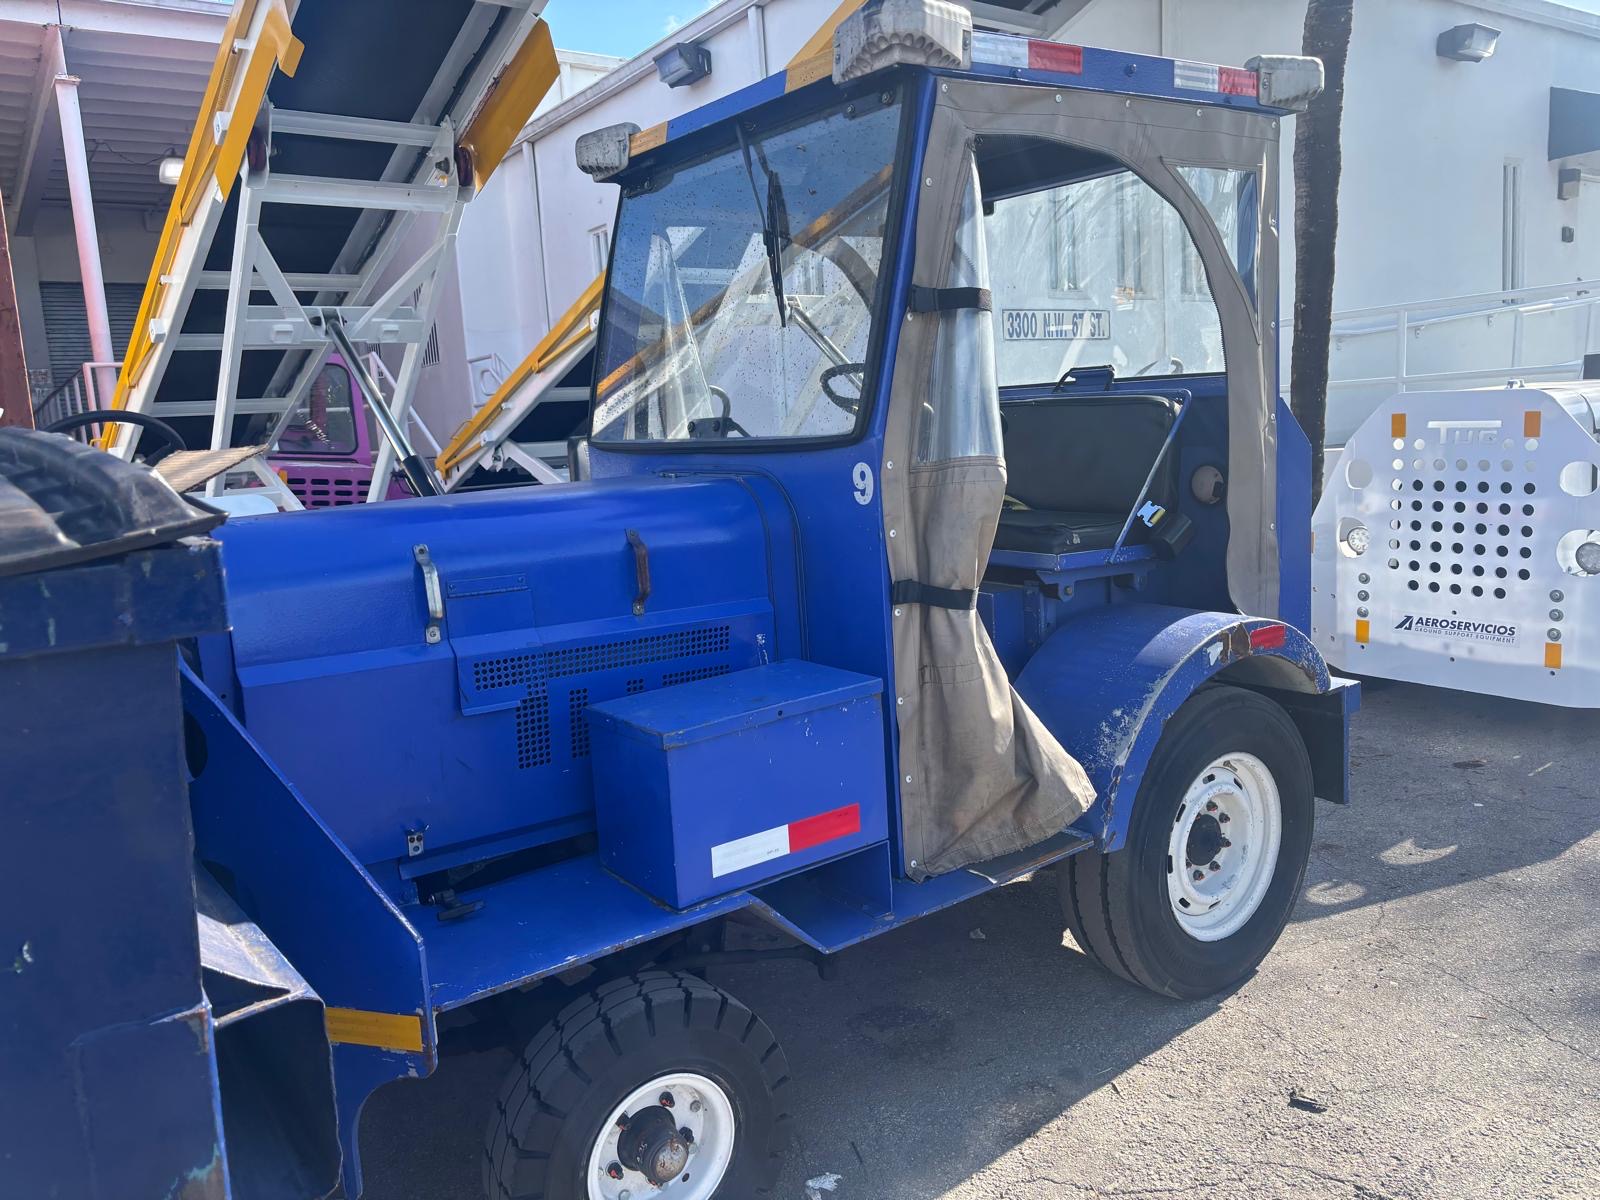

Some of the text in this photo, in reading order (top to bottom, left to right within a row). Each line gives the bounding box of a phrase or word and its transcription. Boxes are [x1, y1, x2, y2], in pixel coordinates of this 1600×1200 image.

[1007, 312, 1037, 338] 3300
[1043, 312, 1068, 338] N.W.
[1090, 312, 1105, 337] ST.
[1427, 420, 1502, 445] TUG
[852, 462, 874, 505] 9
[1414, 627, 1442, 635] GROUND
[1475, 634, 1515, 644] EQUIPMENT
[1415, 617, 1516, 636] AEROSERVICIOS
